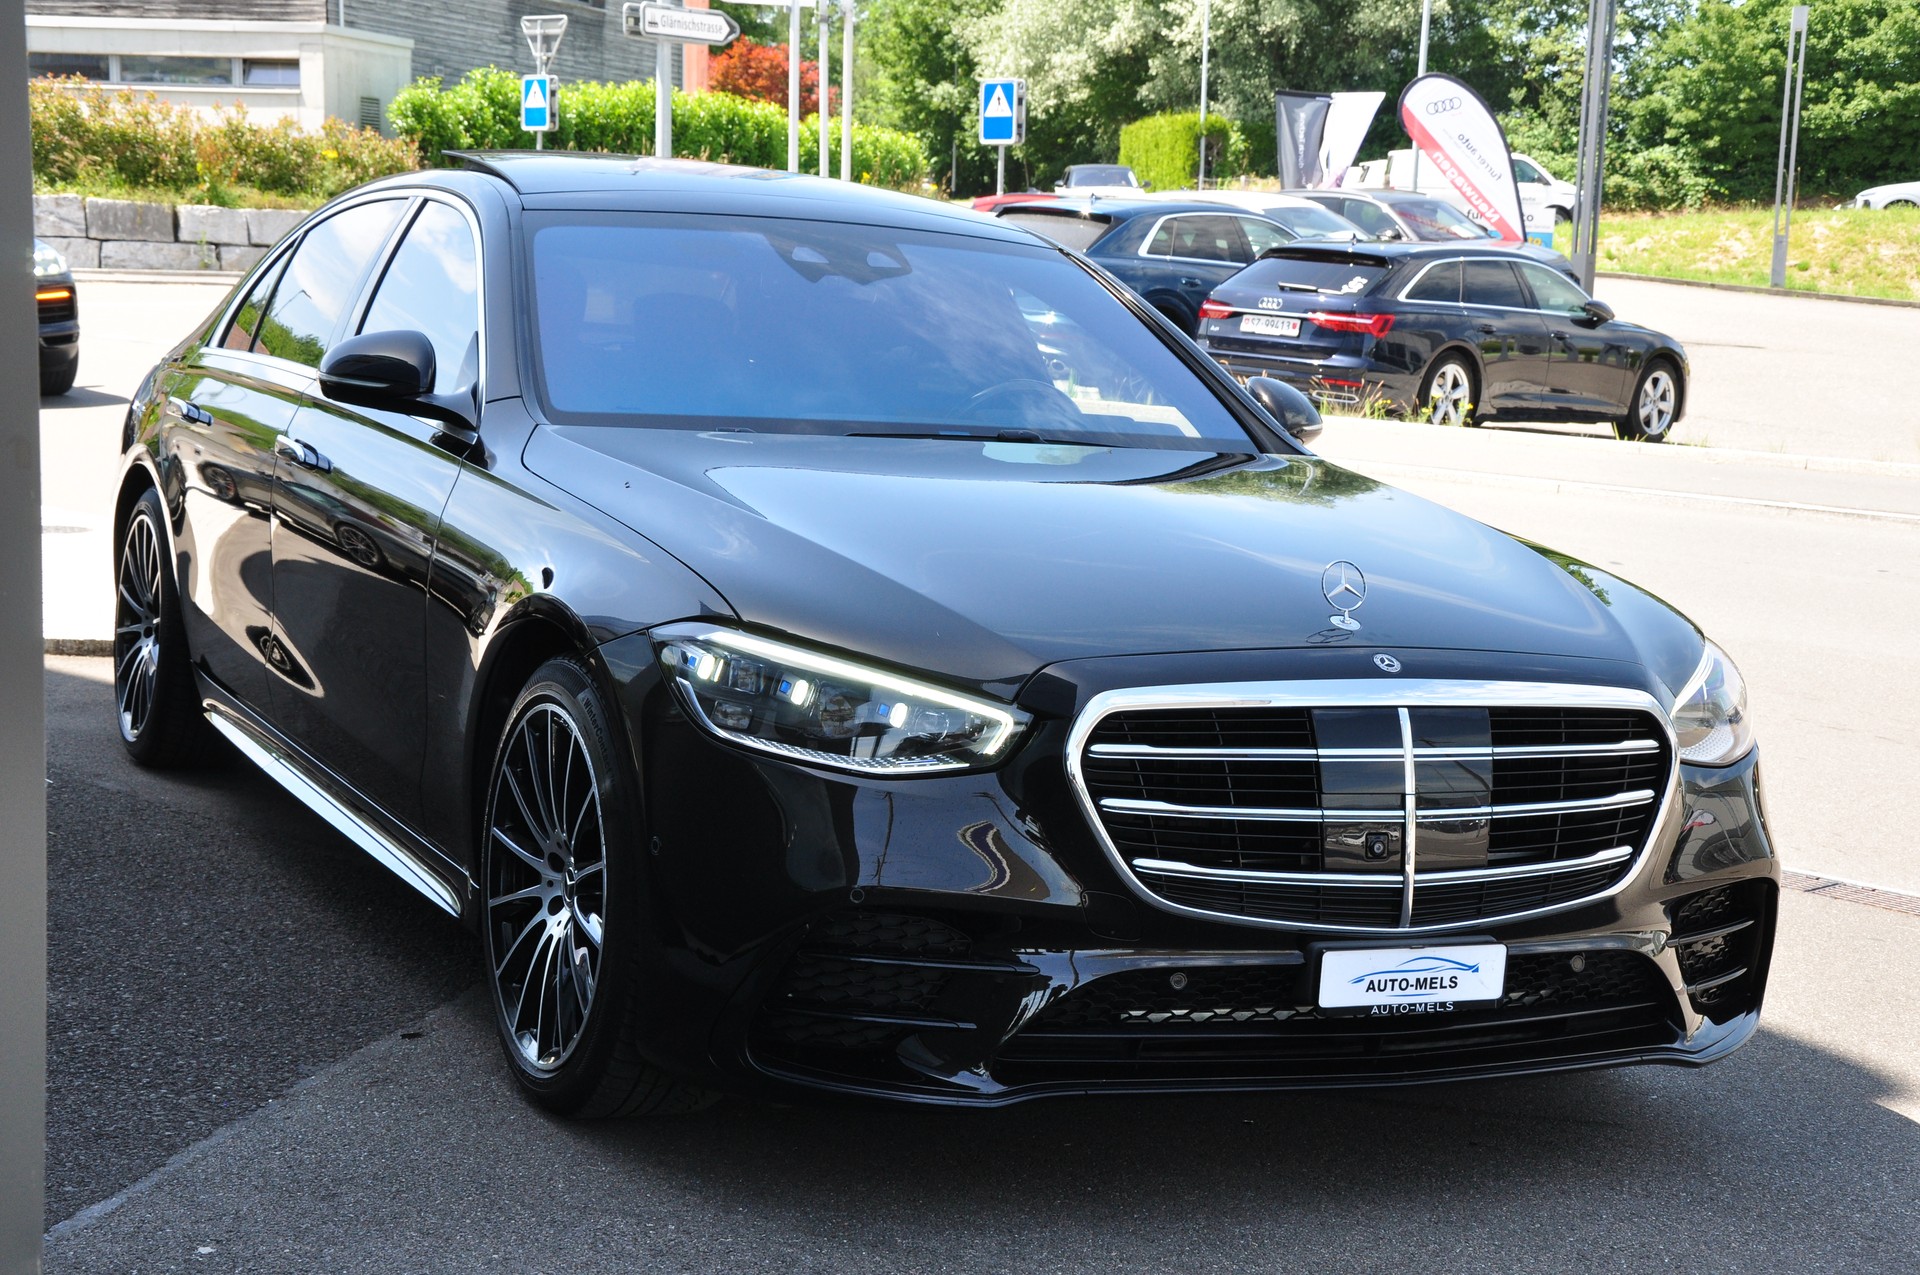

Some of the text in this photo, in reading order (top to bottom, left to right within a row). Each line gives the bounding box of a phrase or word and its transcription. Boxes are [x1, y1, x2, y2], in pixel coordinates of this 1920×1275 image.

[660, 14, 723, 35] Glärnischstrasse
[583, 697, 612, 775] WinterContact
[1365, 975, 1459, 993] AUTO-MELS
[1370, 1001, 1454, 1015] AUTO-MELS
